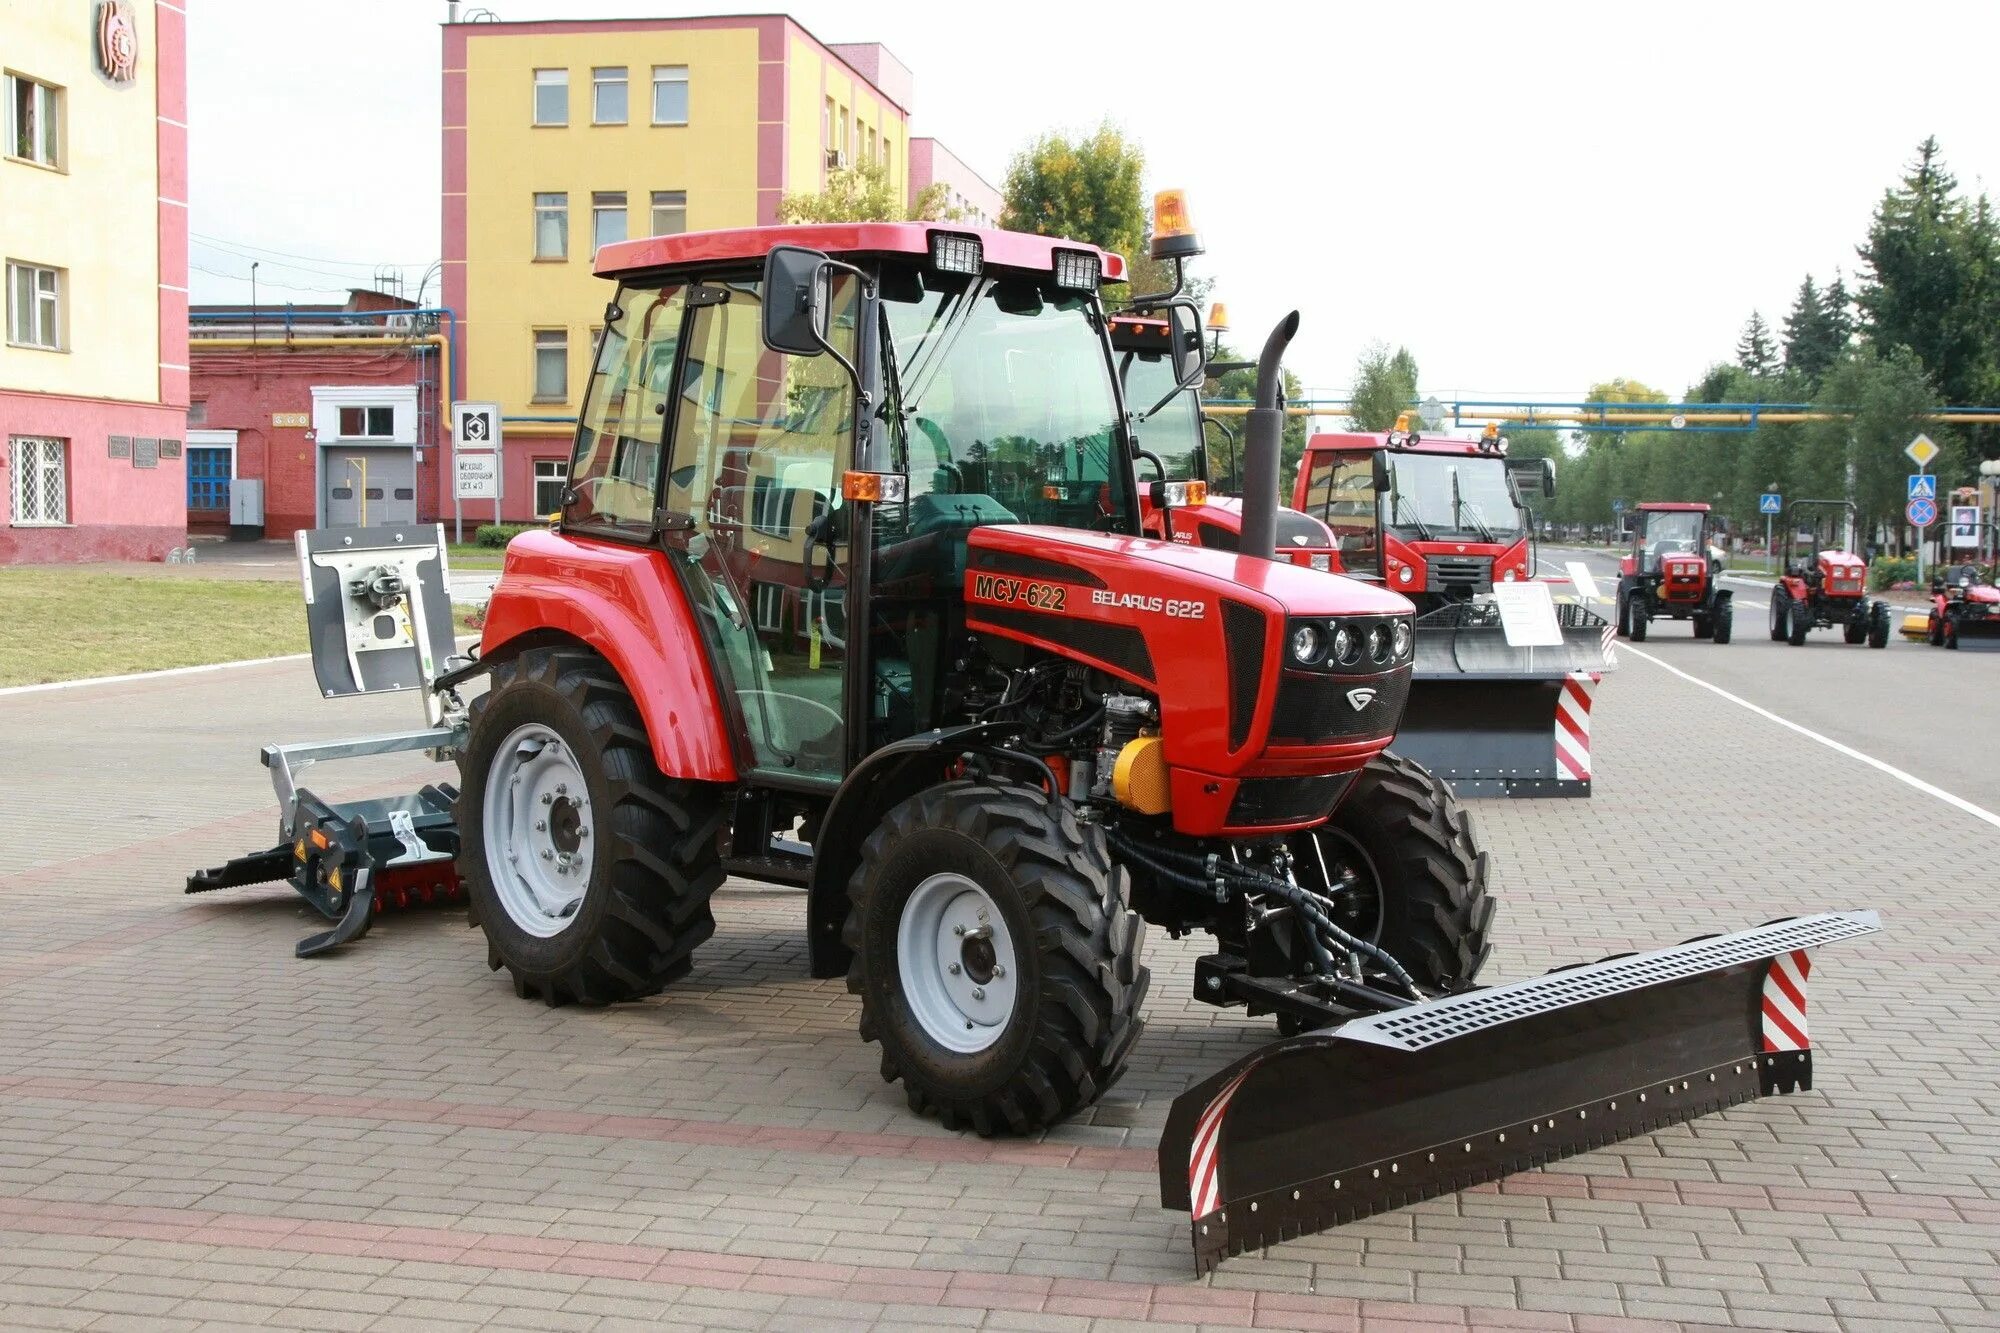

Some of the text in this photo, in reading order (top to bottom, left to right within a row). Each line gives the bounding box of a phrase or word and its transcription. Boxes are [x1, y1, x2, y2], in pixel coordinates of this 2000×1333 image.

[975, 574, 1067, 611] МСУ-622
[1091, 590, 1205, 619] BELARUS 622
